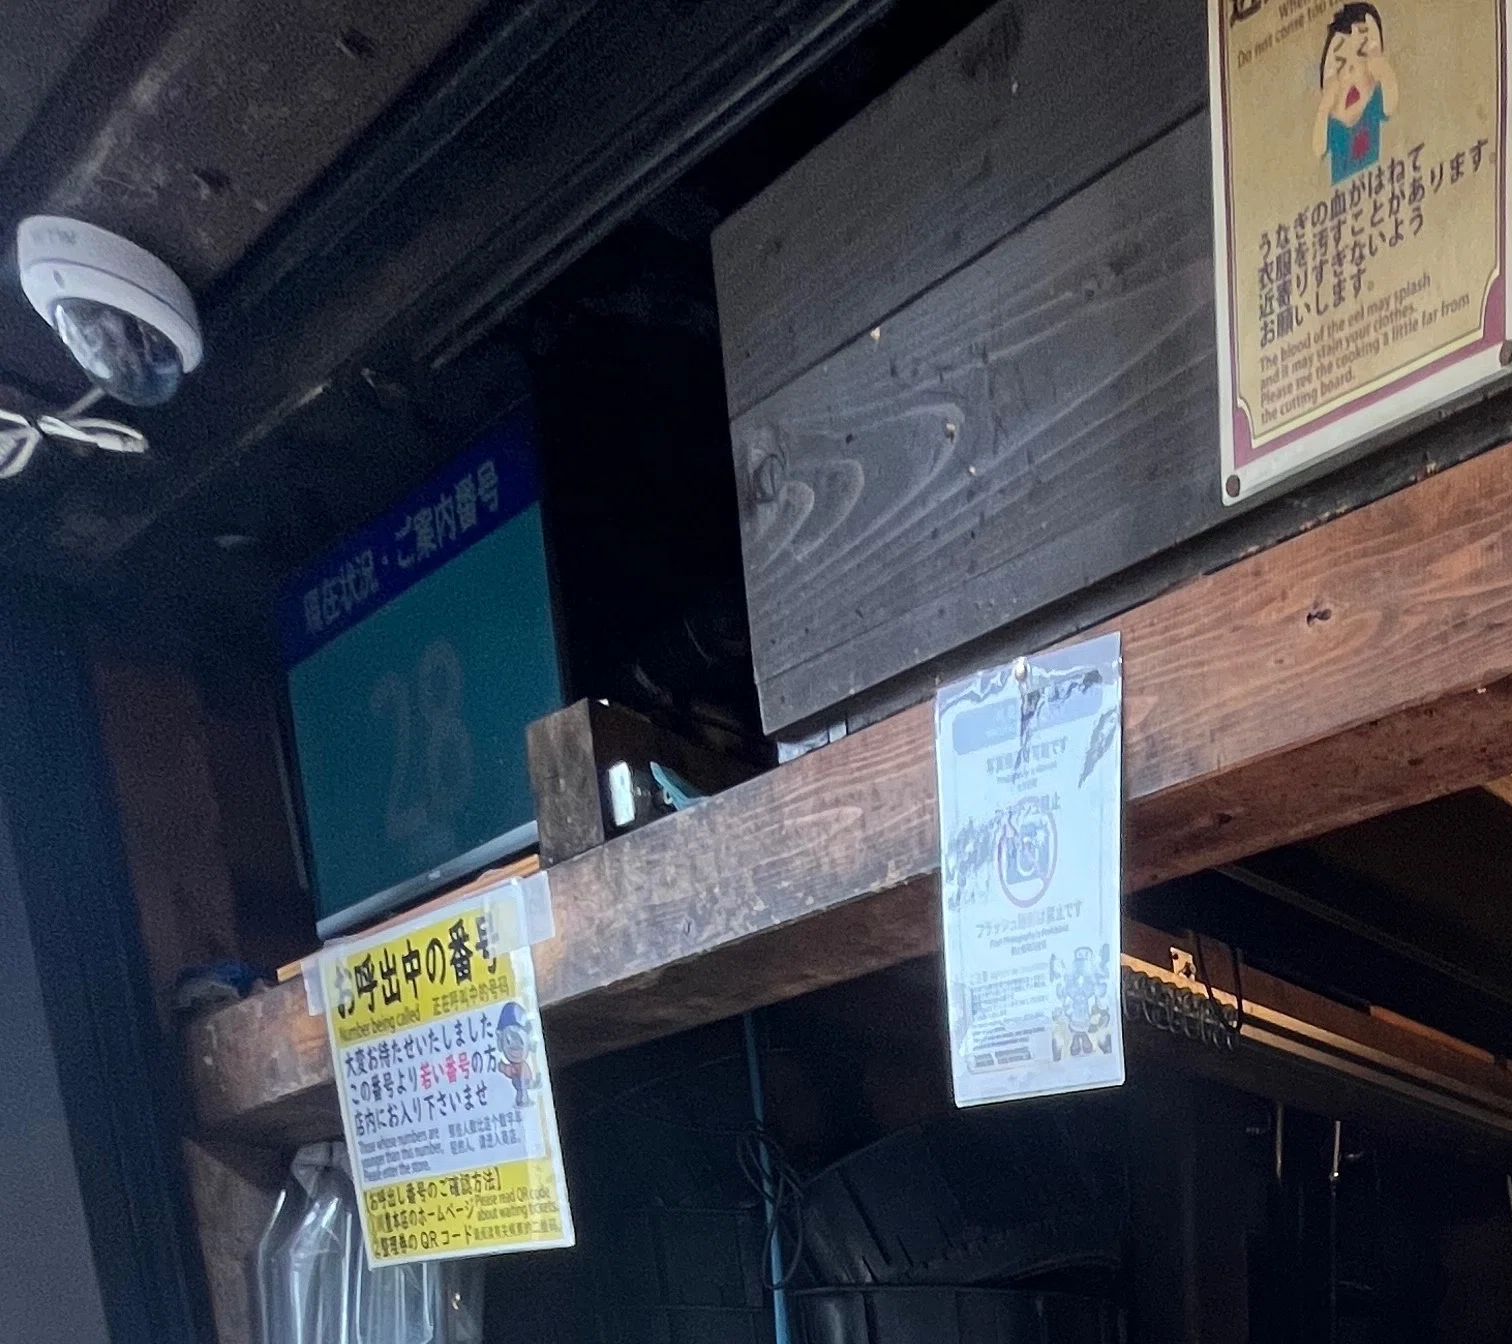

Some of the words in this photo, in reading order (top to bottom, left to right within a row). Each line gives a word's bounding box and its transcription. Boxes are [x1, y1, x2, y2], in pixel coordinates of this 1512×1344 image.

[1259, 142, 1425, 262] うなぎの血がはねて
[1259, 206, 1424, 320] 近寄りすぎないよう
[1261, 353, 1278, 372] The
[1280, 332, 1311, 362] blood
[1313, 323, 1325, 344] of
[1327, 318, 1345, 339] the
[1347, 305, 1365, 326] eel
[1366, 294, 1392, 318] may
[1261, 382, 1294, 409] Please
[1315, 360, 1334, 380] the
[1336, 339, 1380, 368] cooking
[1391, 316, 1419, 343] little
[1440, 291, 1470, 318] from
[1261, 367, 1280, 392] and
[1292, 351, 1315, 375] may
[1344, 321, 1371, 348] your
[1261, 407, 1278, 425] the
[1279, 387, 1319, 417] cutting
[336, 915, 499, 1018] お呼出中の番号
[345, 1012, 493, 1077] 大変お待たせいたしました
[355, 1080, 488, 1136] 店内にお入り下さいませ
